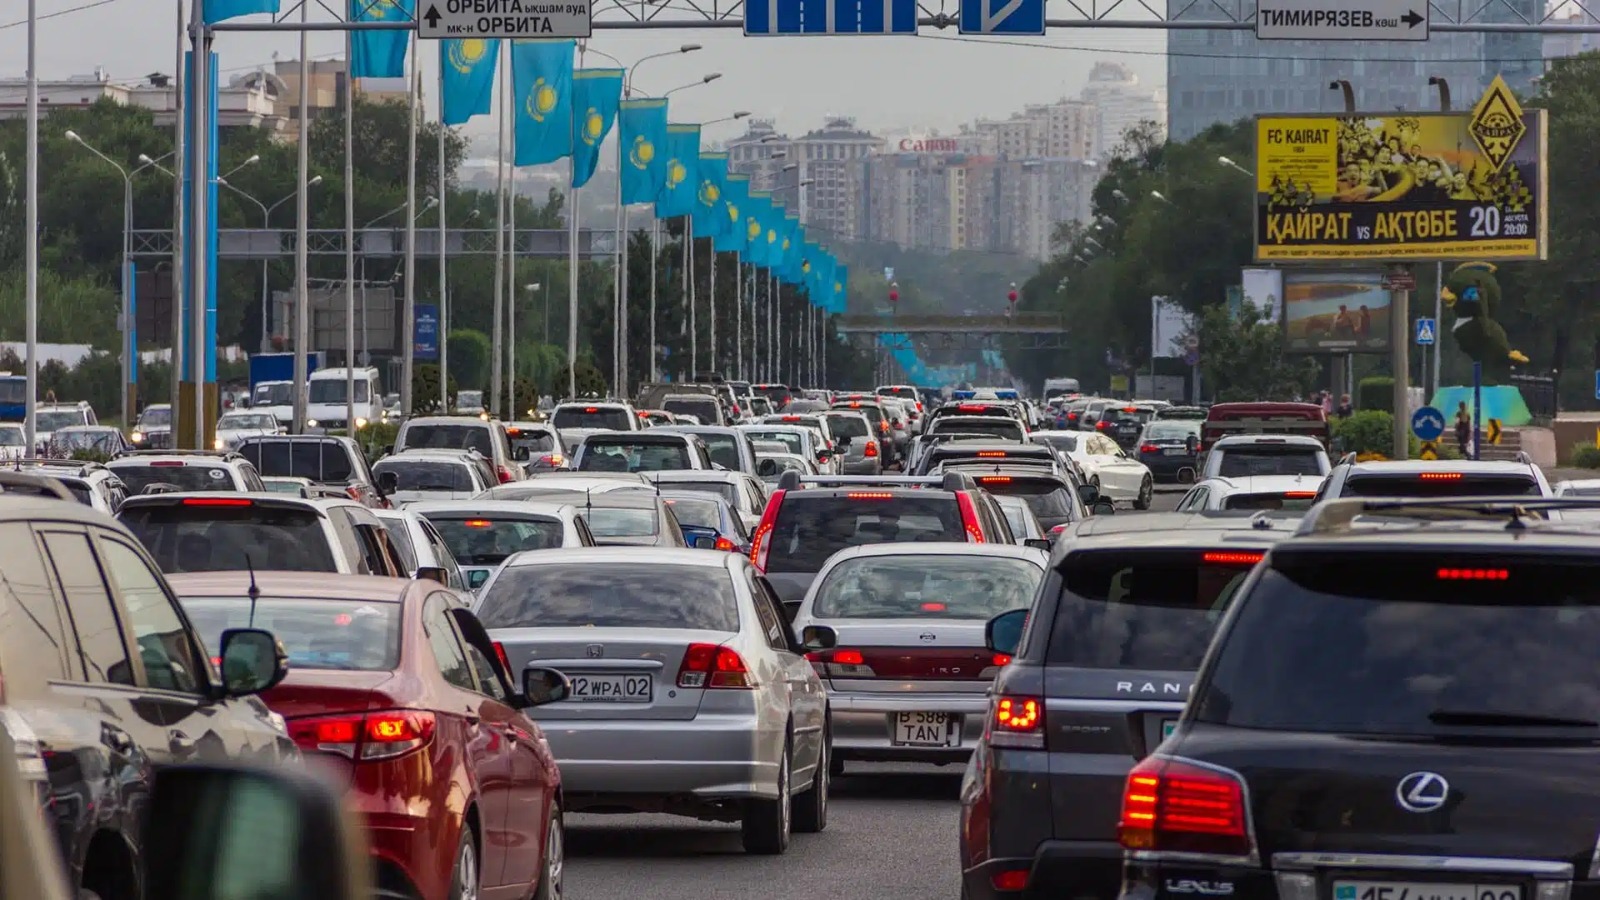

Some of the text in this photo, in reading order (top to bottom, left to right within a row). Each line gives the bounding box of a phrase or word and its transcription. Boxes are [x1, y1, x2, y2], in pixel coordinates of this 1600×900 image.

[446, 0, 586, 16] ОРБИТА ықшам ауд
[446, 16, 553, 34] мк-н ОРБИТА
[1261, 9, 1398, 28] ТИМИРЯЗЕВ көш
[899, 138, 957, 152] Canon
[1267, 129, 1330, 144] FC KAIRAT
[1266, 206, 1353, 244] ҚАЙРАТ
[1374, 209, 1458, 243] АҚТӨБЕ
[1469, 205, 1501, 237] 20
[591, 681, 622, 696] WPA
[626, 678, 649, 696] 02
[903, 725, 940, 741] TAN
[1165, 879, 1234, 896] LEXUS
